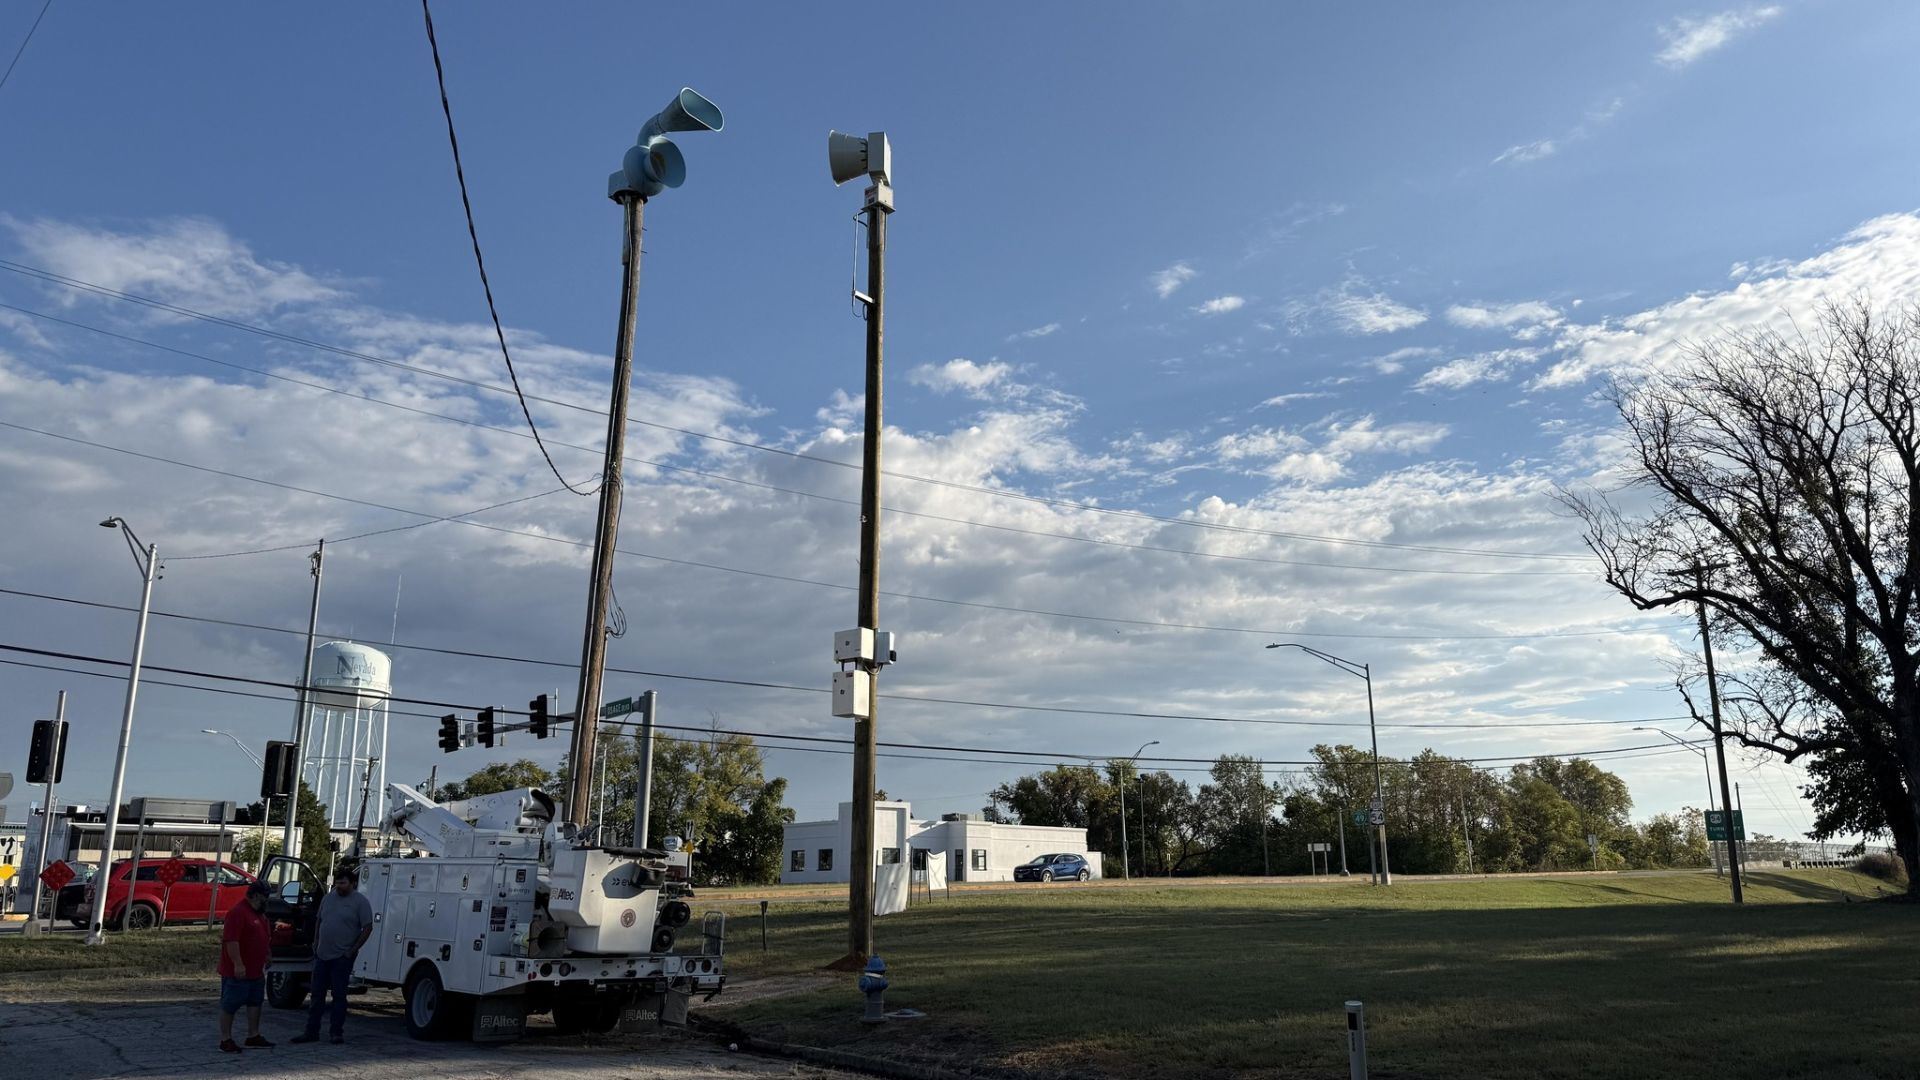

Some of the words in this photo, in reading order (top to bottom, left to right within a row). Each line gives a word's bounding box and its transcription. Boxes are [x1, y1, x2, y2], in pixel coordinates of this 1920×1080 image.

[336, 655, 376, 676] Nevada
[1372, 812, 1384, 822] 54
[557, 888, 575, 901] Altec
[636, 1009, 657, 1020] Altec
[492, 1015, 518, 1027] Altec
